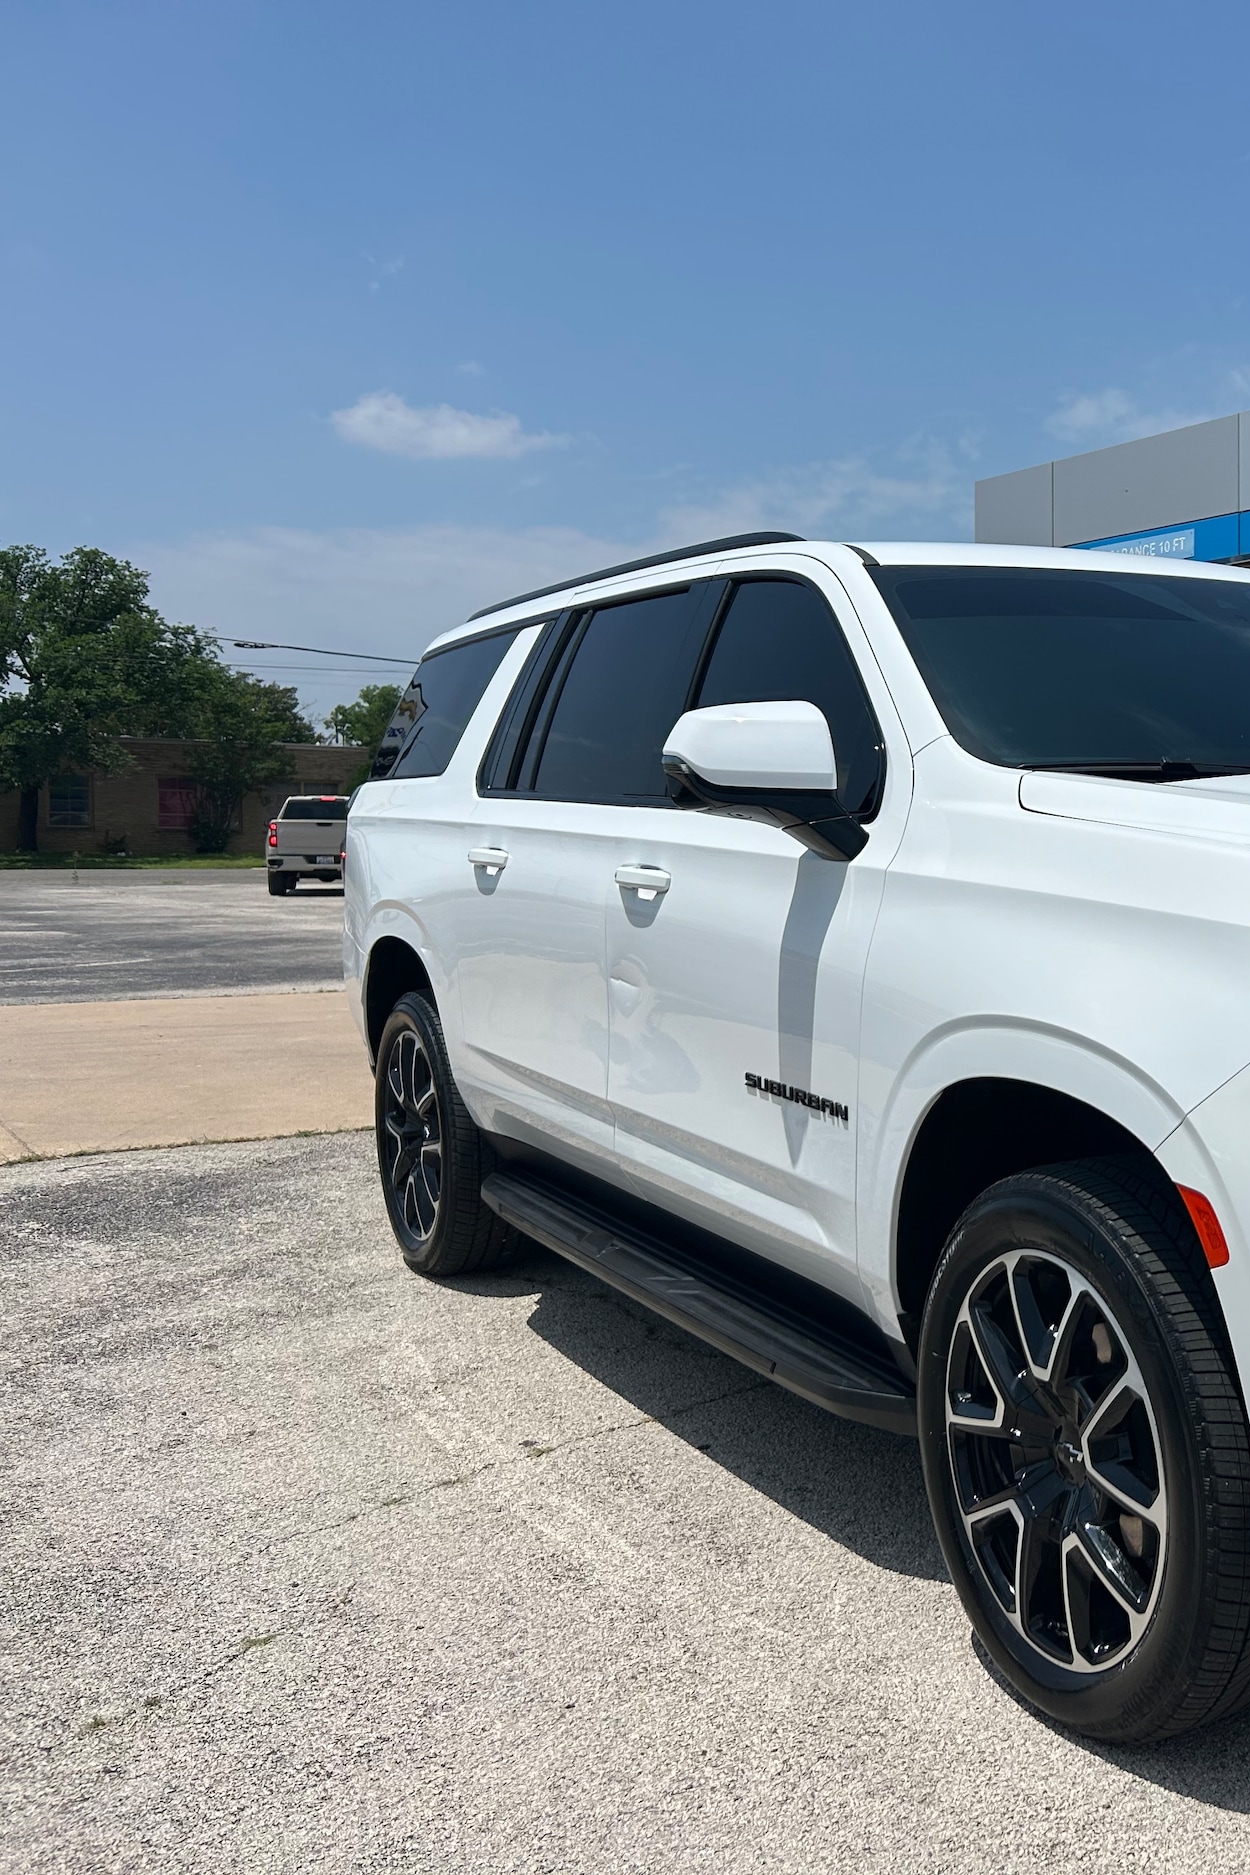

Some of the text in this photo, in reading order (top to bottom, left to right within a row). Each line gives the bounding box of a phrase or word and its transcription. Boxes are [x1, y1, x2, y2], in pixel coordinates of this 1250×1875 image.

[1158, 540, 1170, 554] 10
[1172, 537, 1186, 552] FT
[744, 1072, 849, 1122] SUBURBAN
